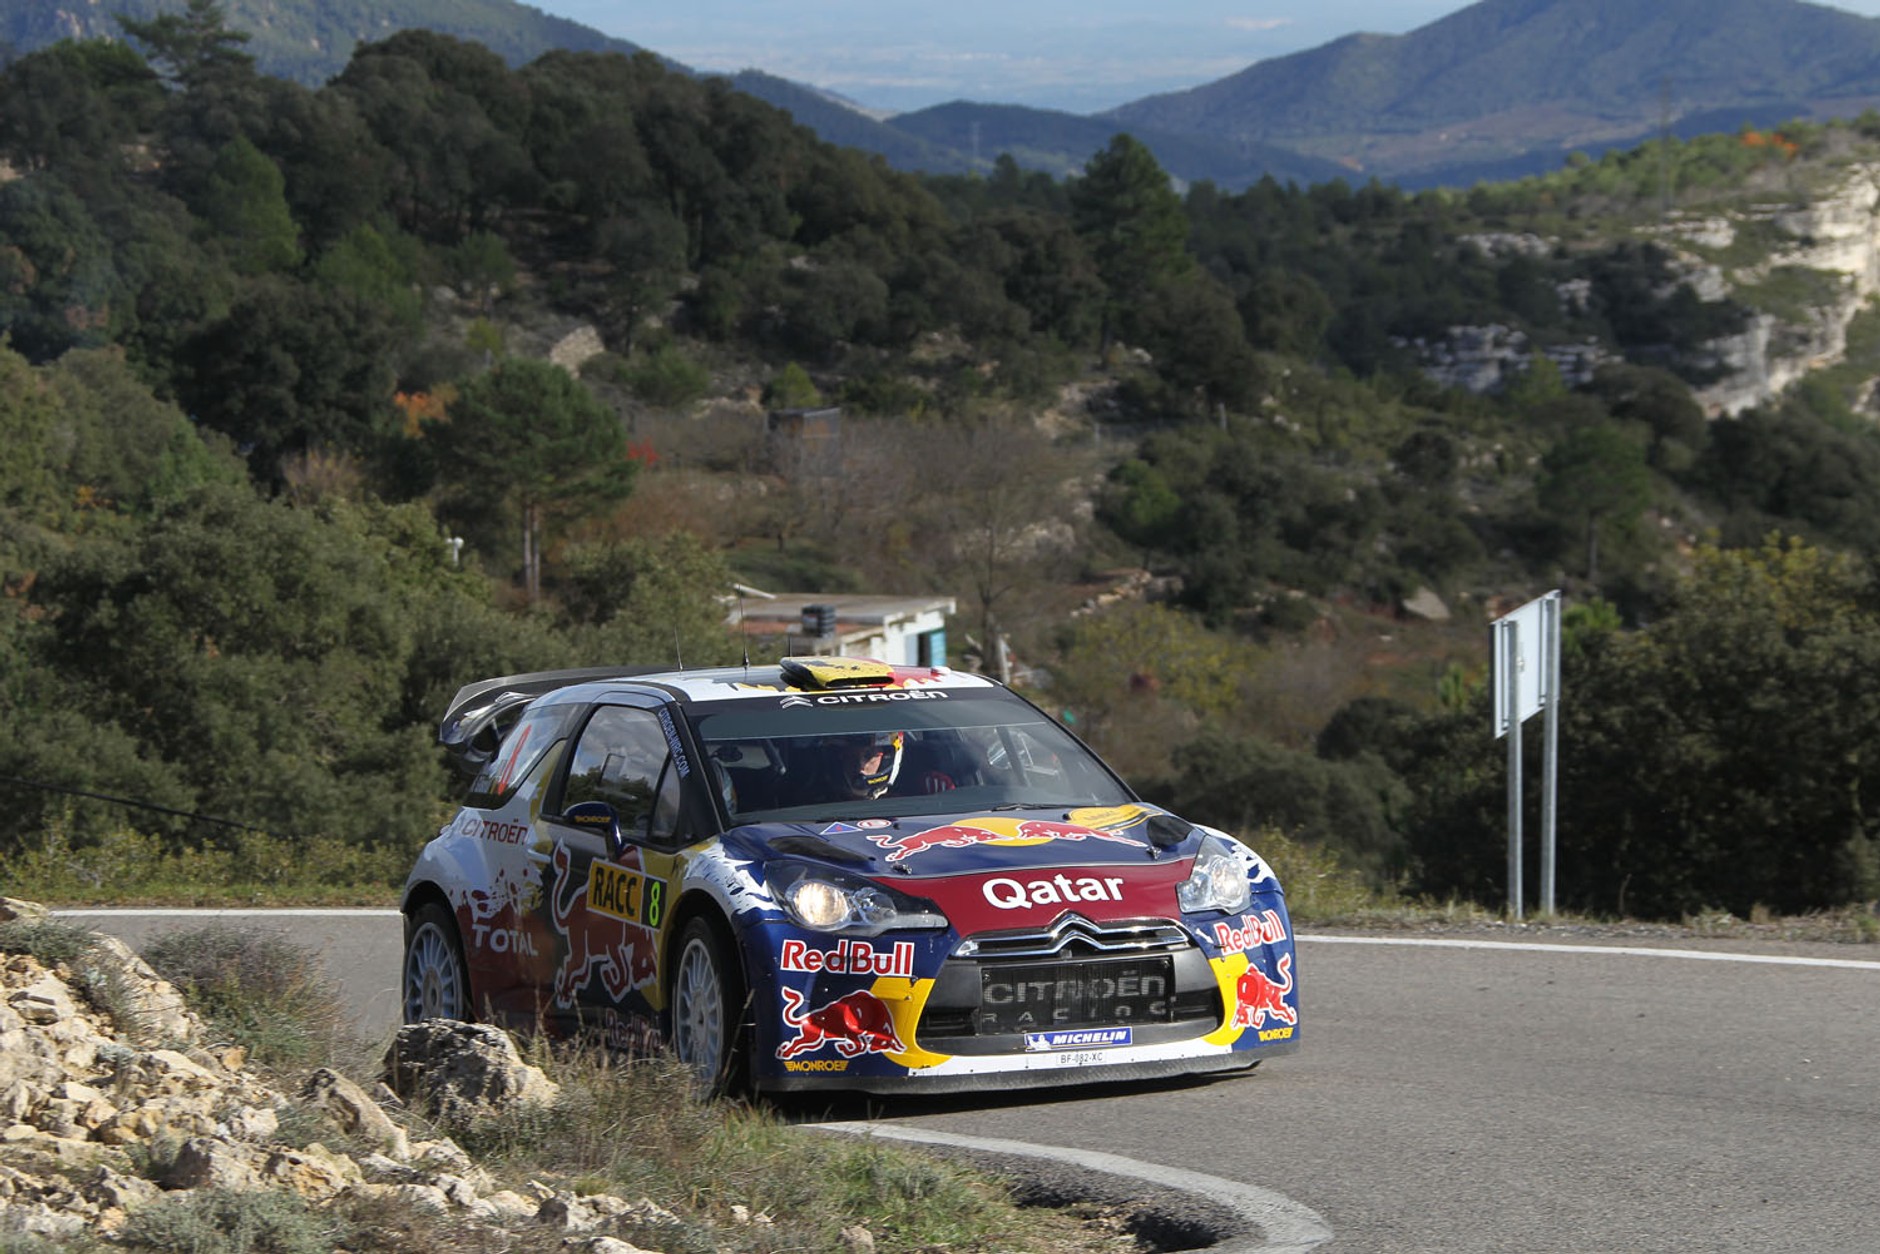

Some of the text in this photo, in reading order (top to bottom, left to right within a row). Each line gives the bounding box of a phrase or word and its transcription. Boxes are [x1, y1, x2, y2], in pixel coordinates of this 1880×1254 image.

[592, 866, 661, 928] RACC 8
[982, 873, 1124, 910] Qatar
[472, 923, 539, 957] TOTAL
[1052, 1030, 1127, 1045] MICHELIN
[784, 1060, 848, 1072] MONROE
